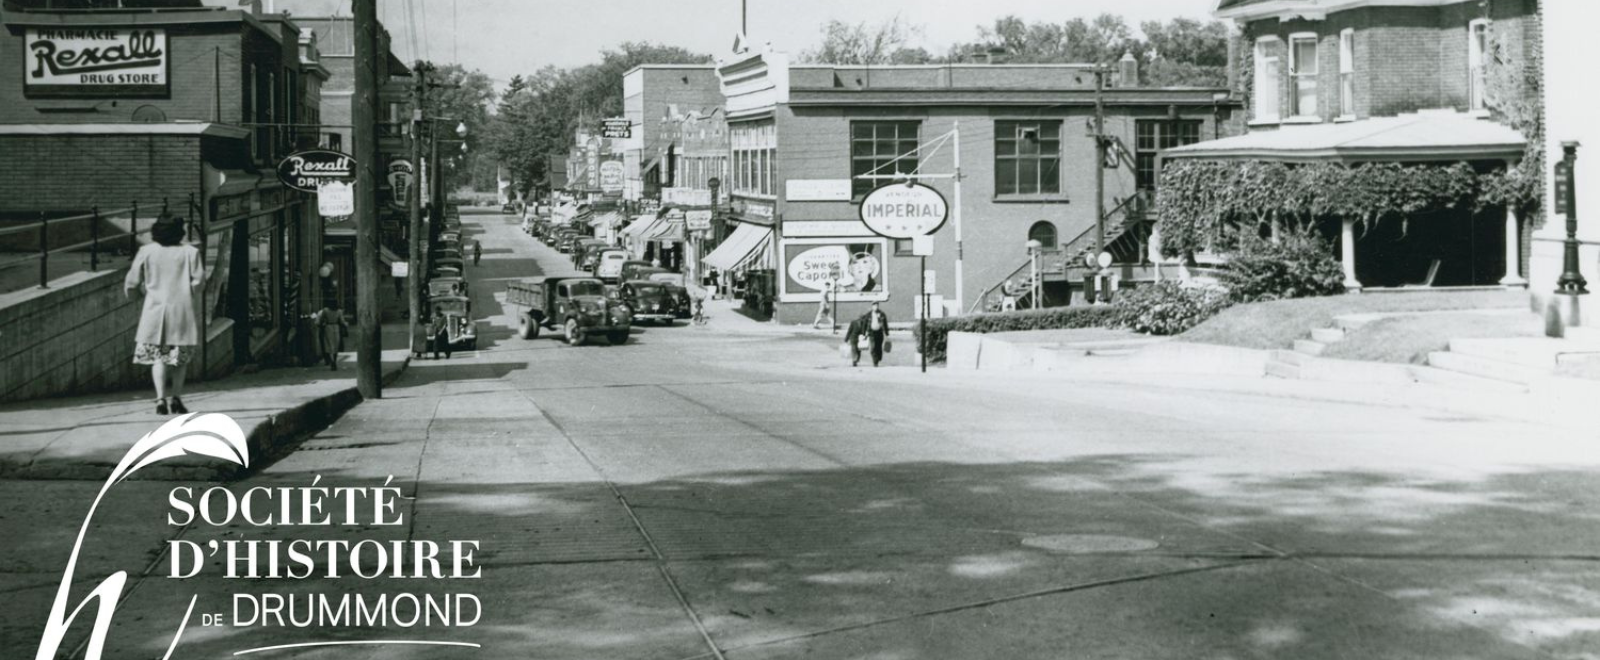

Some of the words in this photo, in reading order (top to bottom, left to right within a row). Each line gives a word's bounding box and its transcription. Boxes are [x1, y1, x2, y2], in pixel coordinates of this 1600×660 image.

[38, 30, 118, 40] PHARMACIE
[30, 30, 162, 78] Rexall
[80, 74, 115, 83] DRUG
[118, 73, 159, 83] STORE
[290, 156, 351, 176] Rexall
[867, 203, 942, 218] IMPERIAL
[797, 271, 845, 282] Caporl
